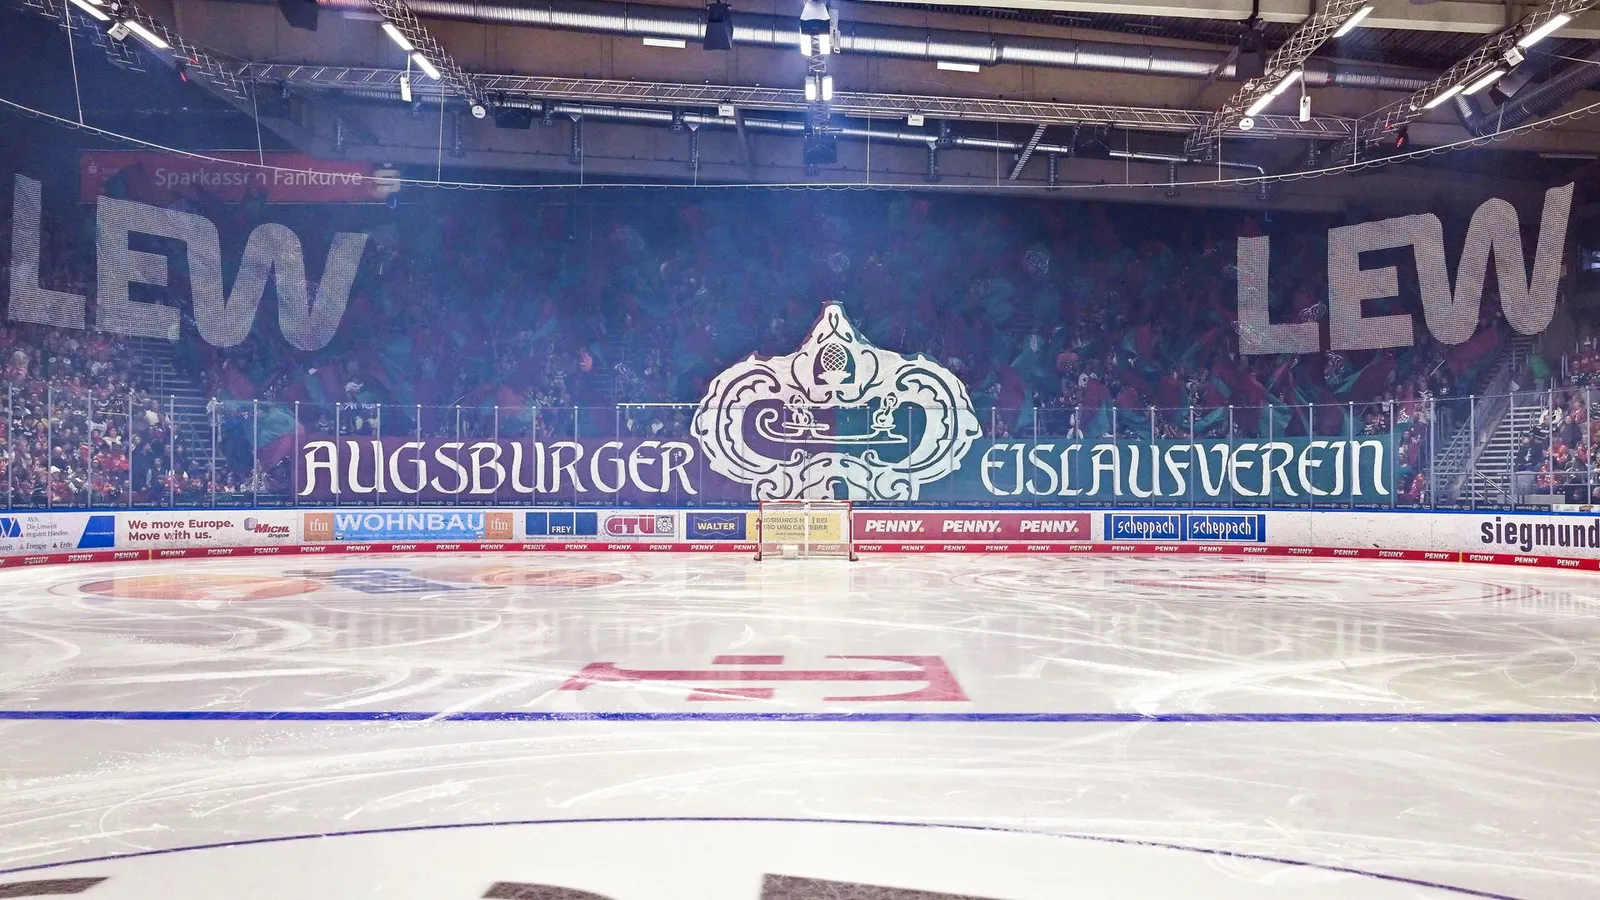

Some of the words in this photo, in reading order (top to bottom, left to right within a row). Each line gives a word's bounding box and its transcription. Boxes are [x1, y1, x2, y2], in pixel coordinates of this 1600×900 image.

[274, 168, 363, 186] Fankurve
[8, 173, 368, 351] LEW
[1237, 182, 1575, 356] LEW
[298, 440, 698, 495] AUGSBURGER
[980, 440, 1390, 497] EISLAUFVEREIN
[128, 520, 148, 530] We
[151, 521, 184, 529] move
[188, 519, 234, 530] Europe.
[309, 518, 328, 532] tfm
[335, 513, 484, 531] WOHNBAU
[491, 517, 508, 531] tfm
[607, 514, 655, 534] GTÜ
[697, 522, 735, 531] WALTER
[1117, 515, 1175, 540] scheppach
[1193, 515, 1251, 540] scheppach
[128, 531, 160, 541] Move
[163, 529, 191, 540] with
[195, 531, 212, 539] us.
[1480, 516, 1600, 553] siegmund
